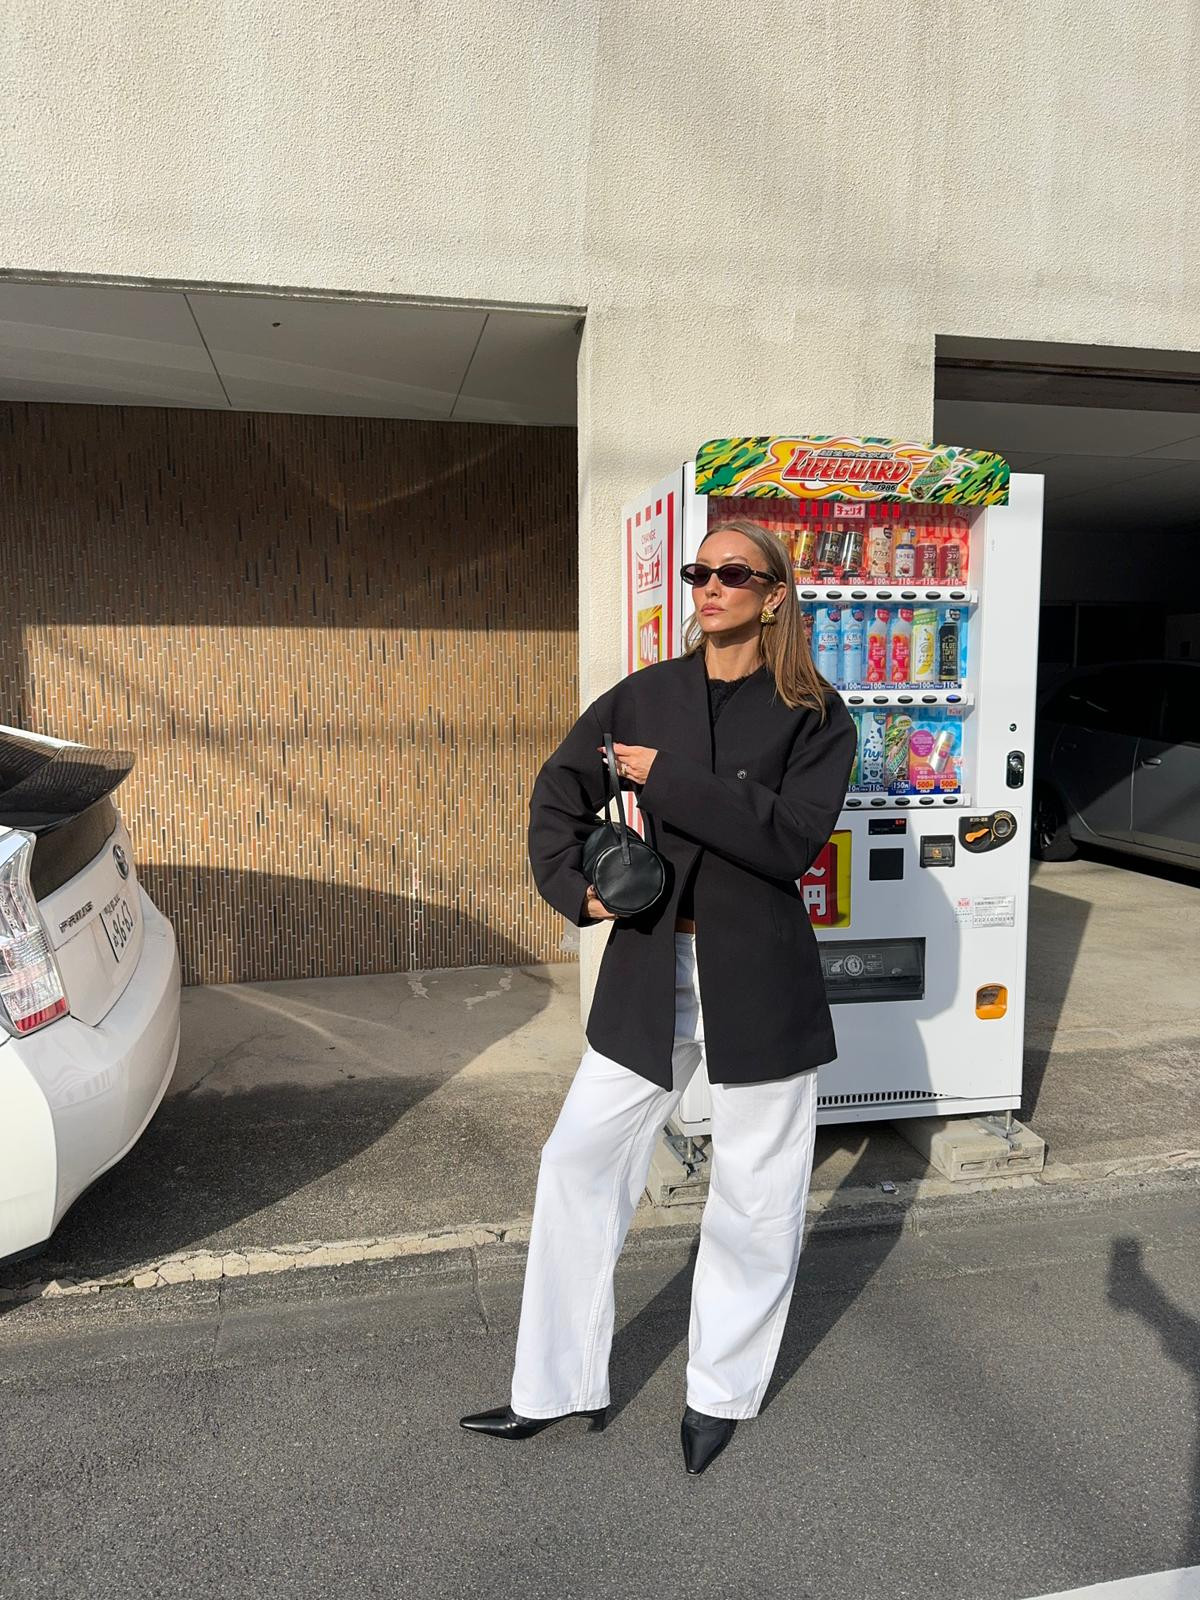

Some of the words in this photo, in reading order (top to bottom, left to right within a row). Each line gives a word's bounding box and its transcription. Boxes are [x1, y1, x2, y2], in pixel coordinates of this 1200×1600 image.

[782, 448, 912, 484] LIFEGUARD
[877, 484, 897, 492] 1986
[836, 504, 863, 516] チェリオ
[638, 554, 661, 589] チェリオ
